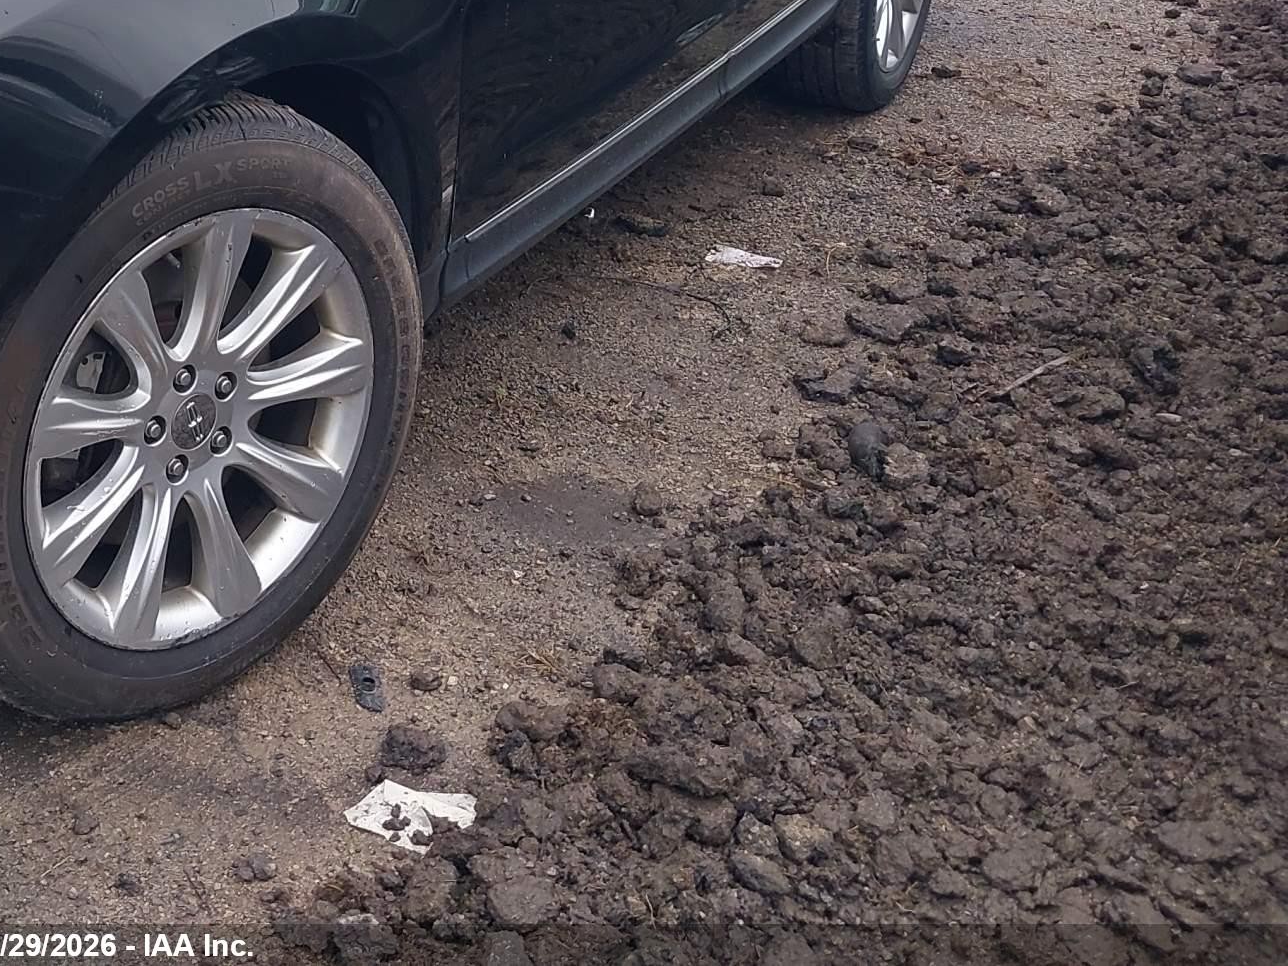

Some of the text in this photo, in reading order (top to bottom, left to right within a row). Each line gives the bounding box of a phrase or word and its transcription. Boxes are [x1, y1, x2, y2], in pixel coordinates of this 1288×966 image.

[132, 177, 189, 218] CROSS
[193, 161, 236, 192] LX
[237, 157, 290, 172] SPORT
